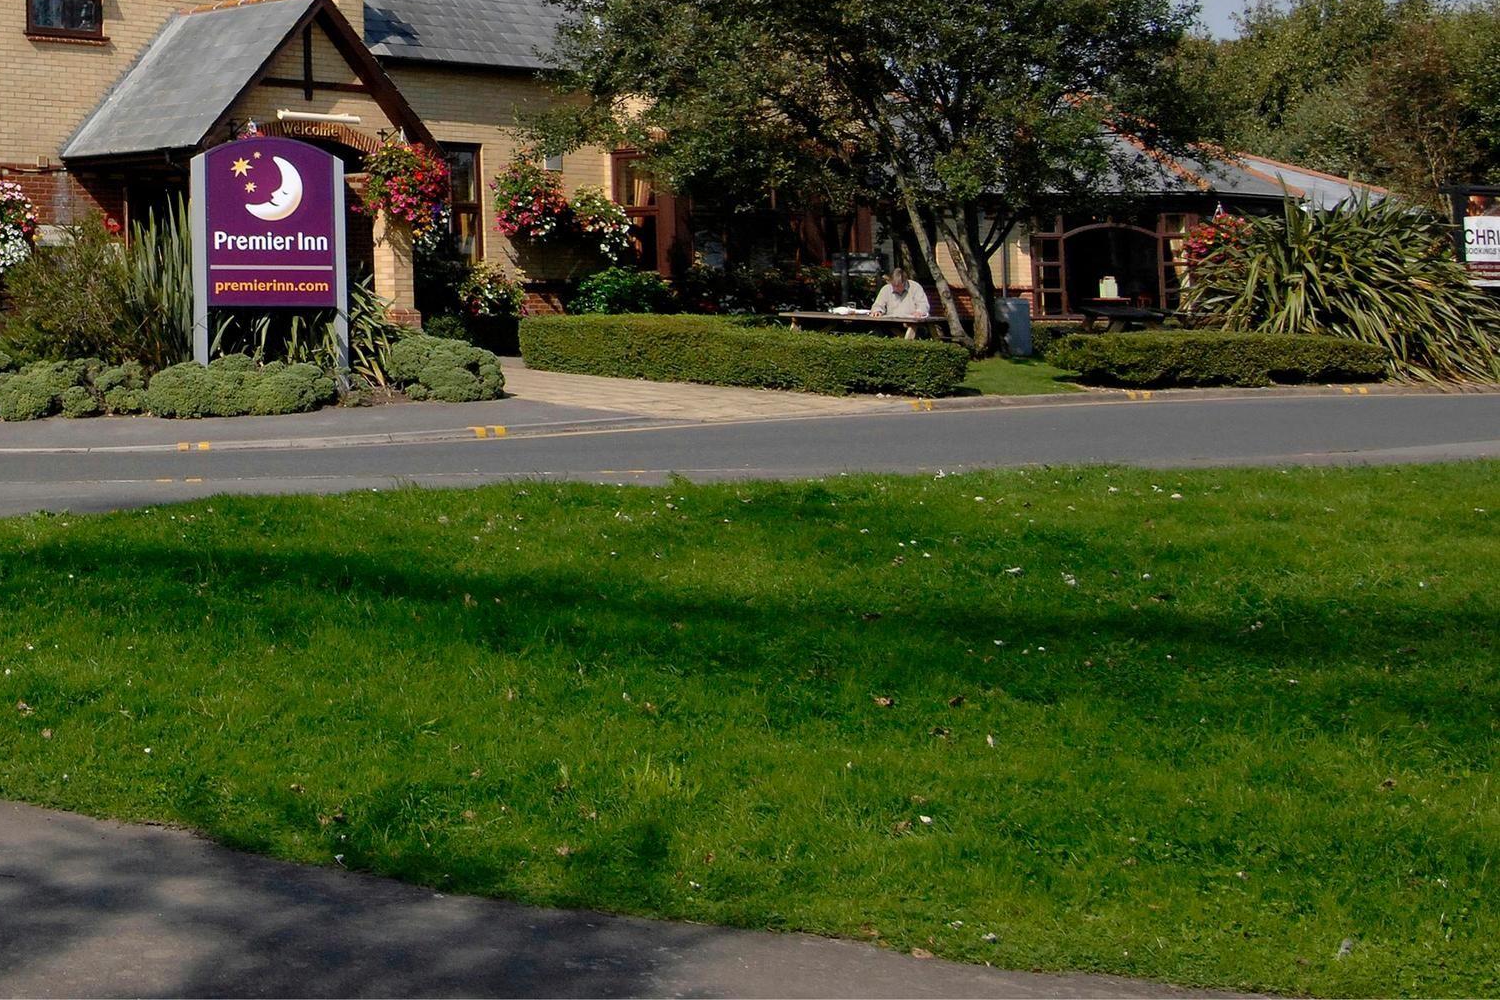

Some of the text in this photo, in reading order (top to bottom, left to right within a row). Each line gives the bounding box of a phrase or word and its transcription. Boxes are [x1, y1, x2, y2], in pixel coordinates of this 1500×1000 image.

[282, 121, 339, 137] Welcome
[214, 231, 329, 251] Premier Inn
[215, 279, 329, 294] premierinn.com
